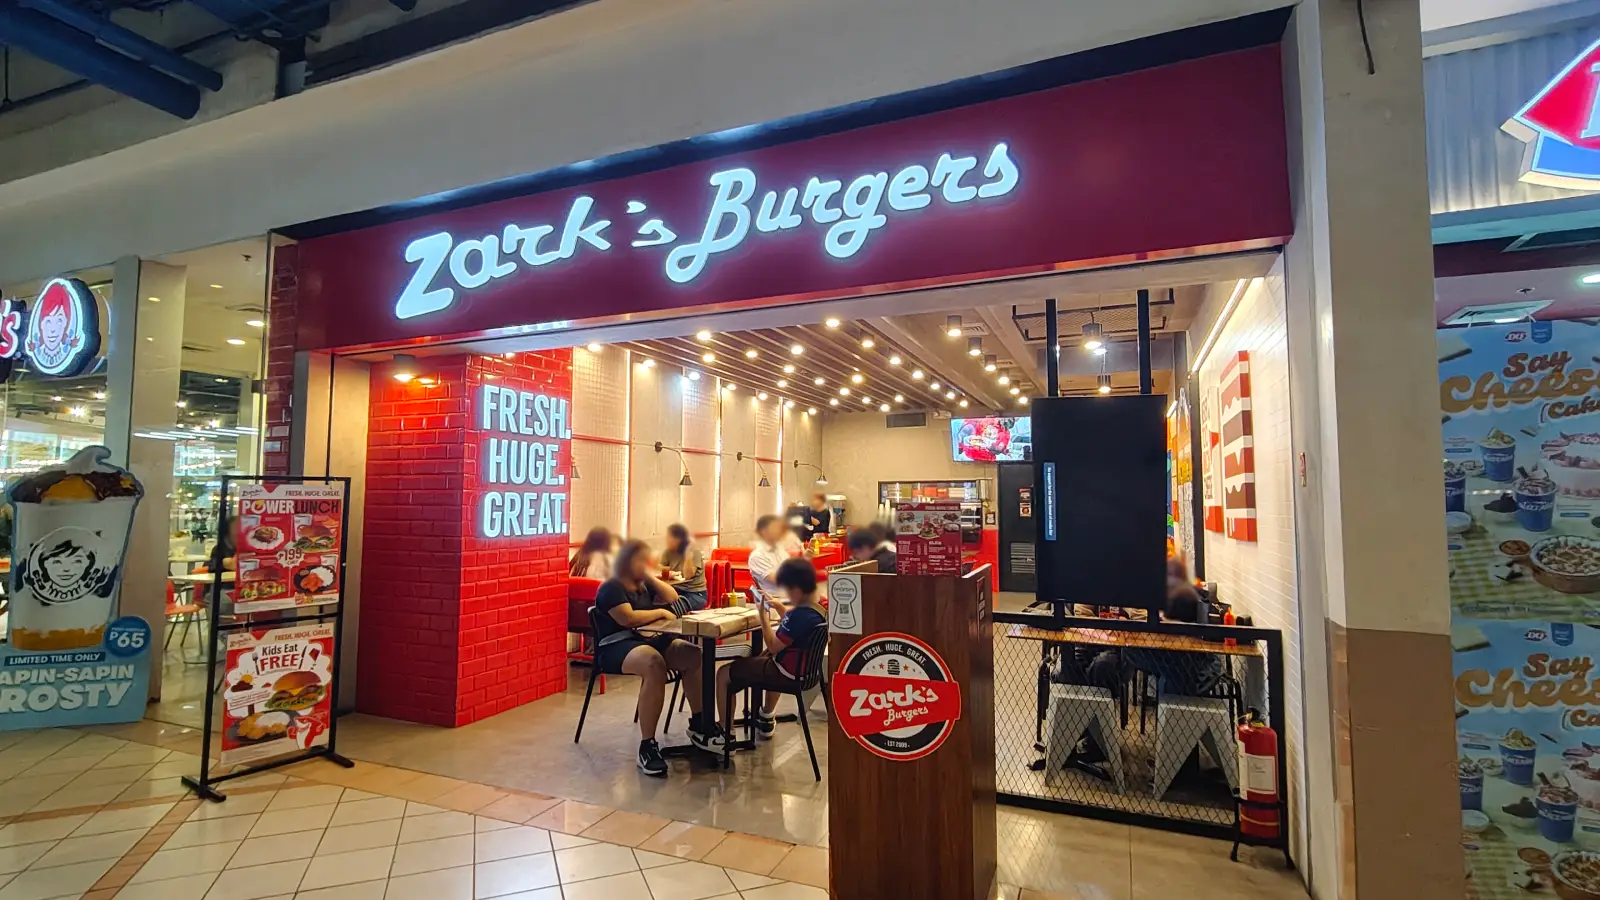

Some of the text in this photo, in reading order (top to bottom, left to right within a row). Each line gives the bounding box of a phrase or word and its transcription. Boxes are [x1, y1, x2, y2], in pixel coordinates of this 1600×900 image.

[395, 143, 1019, 319] Zark's Burgers
[1503, 351, 1572, 377] Say
[1440, 368, 1600, 413] Chees
[483, 384, 571, 440] FRESH.
[489, 438, 564, 485] HUGE.
[483, 491, 568, 538] GREAT.
[9, 653, 100, 665] LIMITED TIME ONLY
[260, 653, 300, 672] FREE
[262, 644, 298, 656] Kids Eat
[862, 643, 926, 666] FRESH. HUGE. GREAT.
[1523, 653, 1594, 680] Say
[850, 684, 939, 717] Zark's
[883, 706, 929, 726] Burgers
